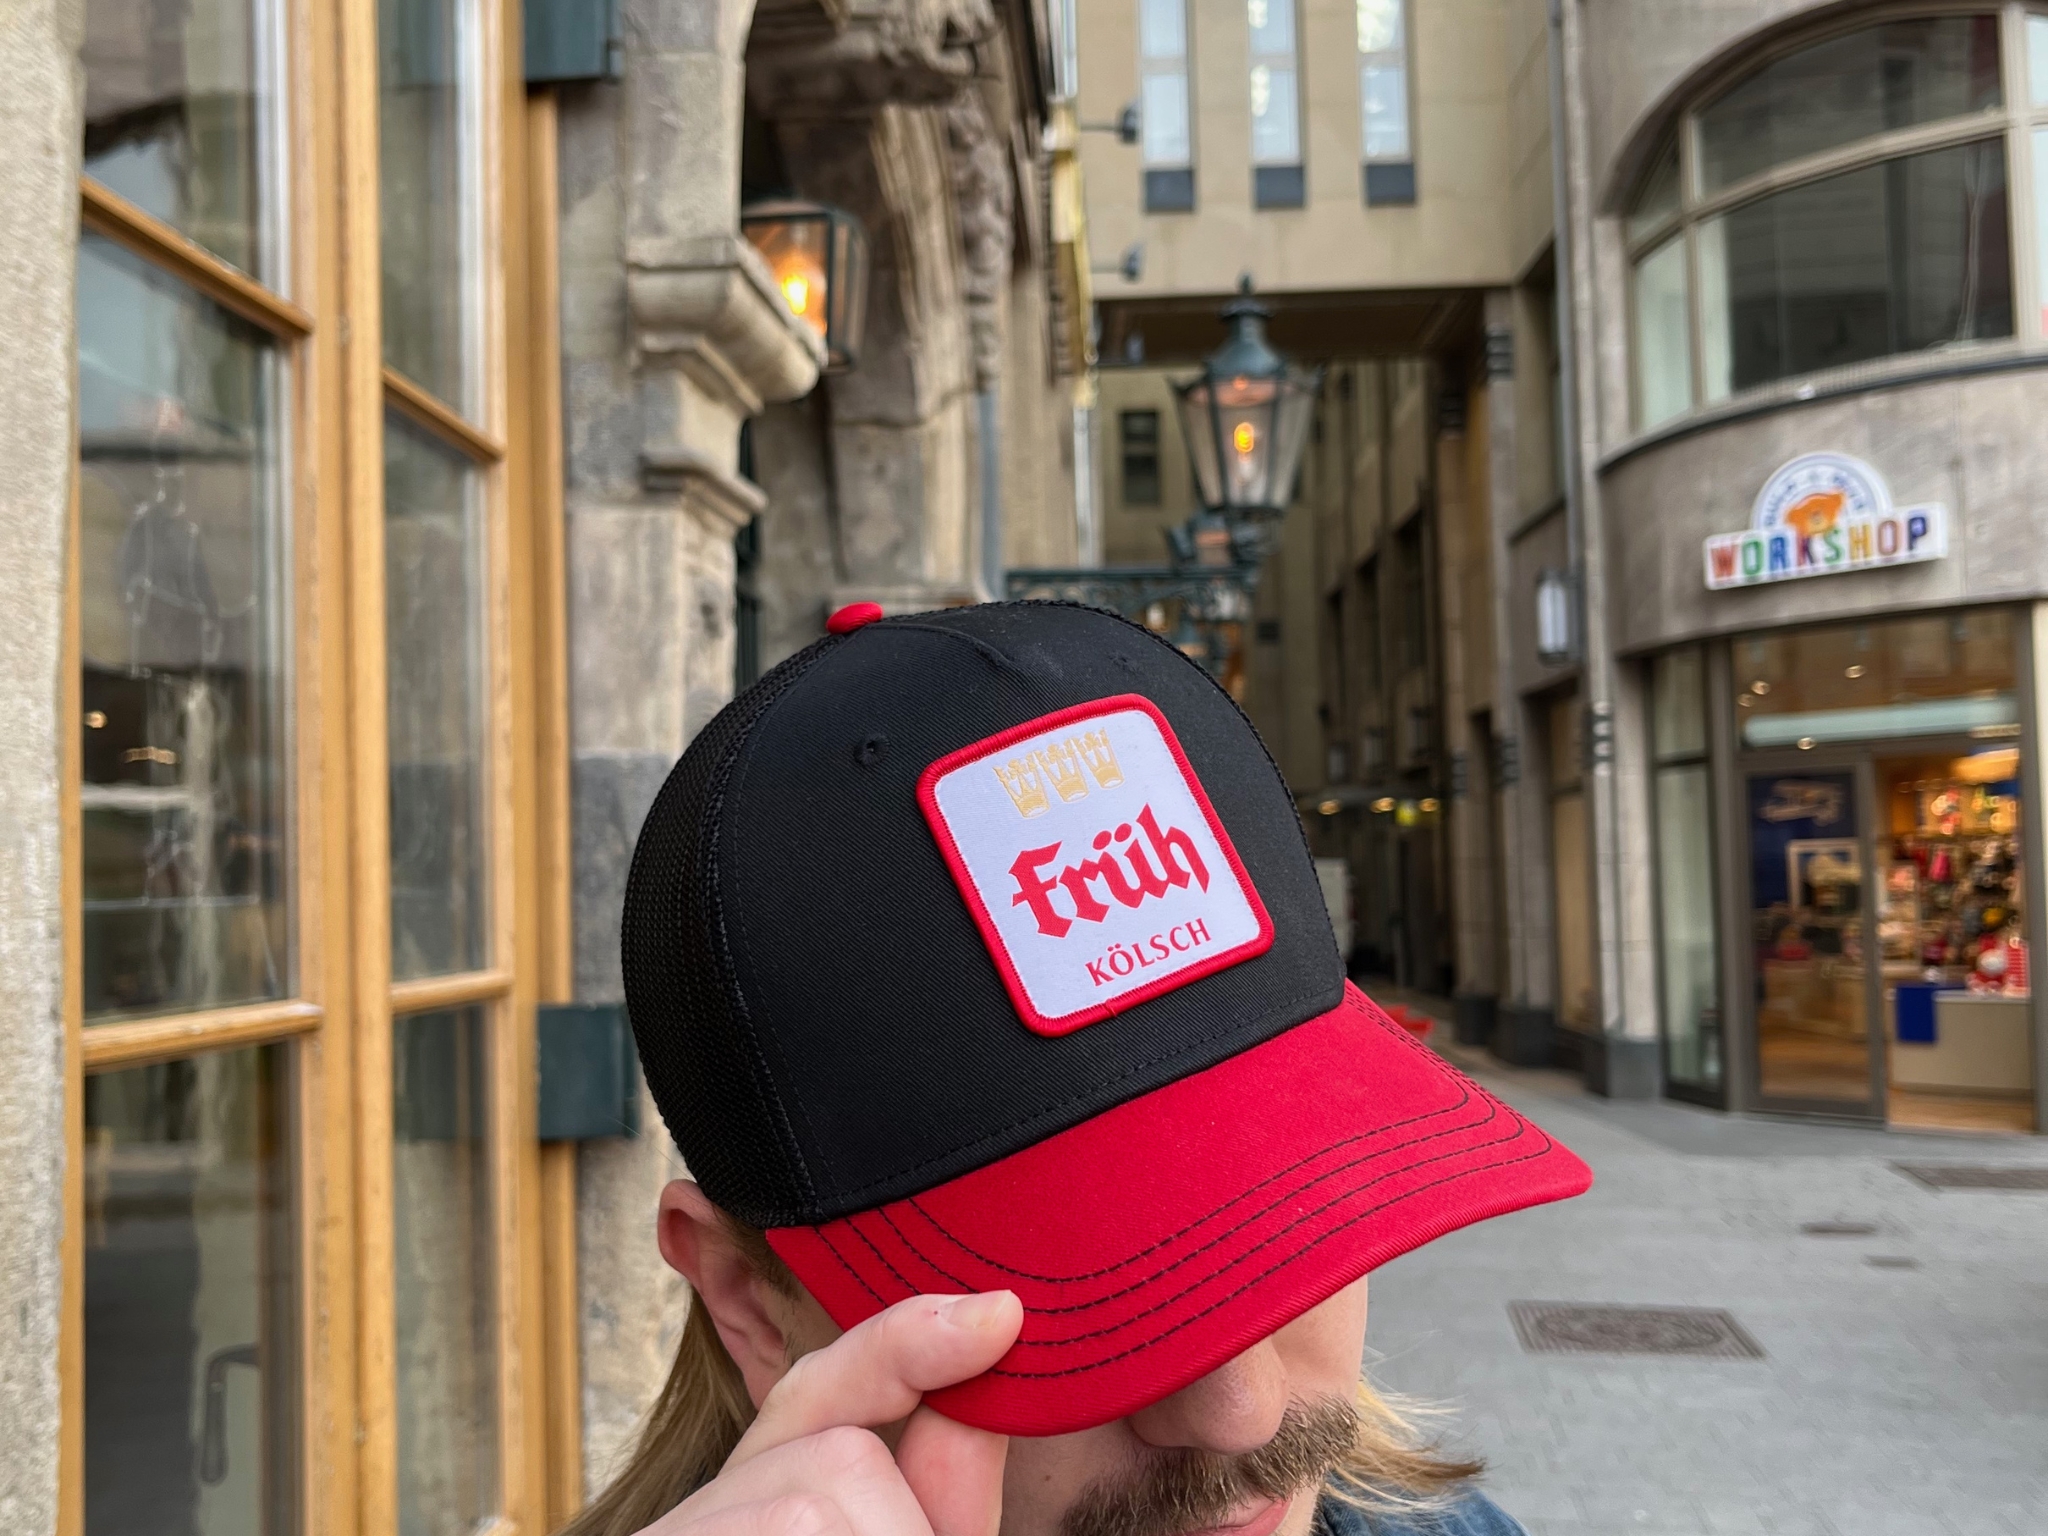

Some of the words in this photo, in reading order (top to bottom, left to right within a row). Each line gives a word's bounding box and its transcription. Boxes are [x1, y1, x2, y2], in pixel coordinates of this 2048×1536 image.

[1711, 516, 1927, 577] WORKSHOP
[1008, 803, 1210, 938] Früh
[1085, 918, 1212, 987] KÖLSCH
